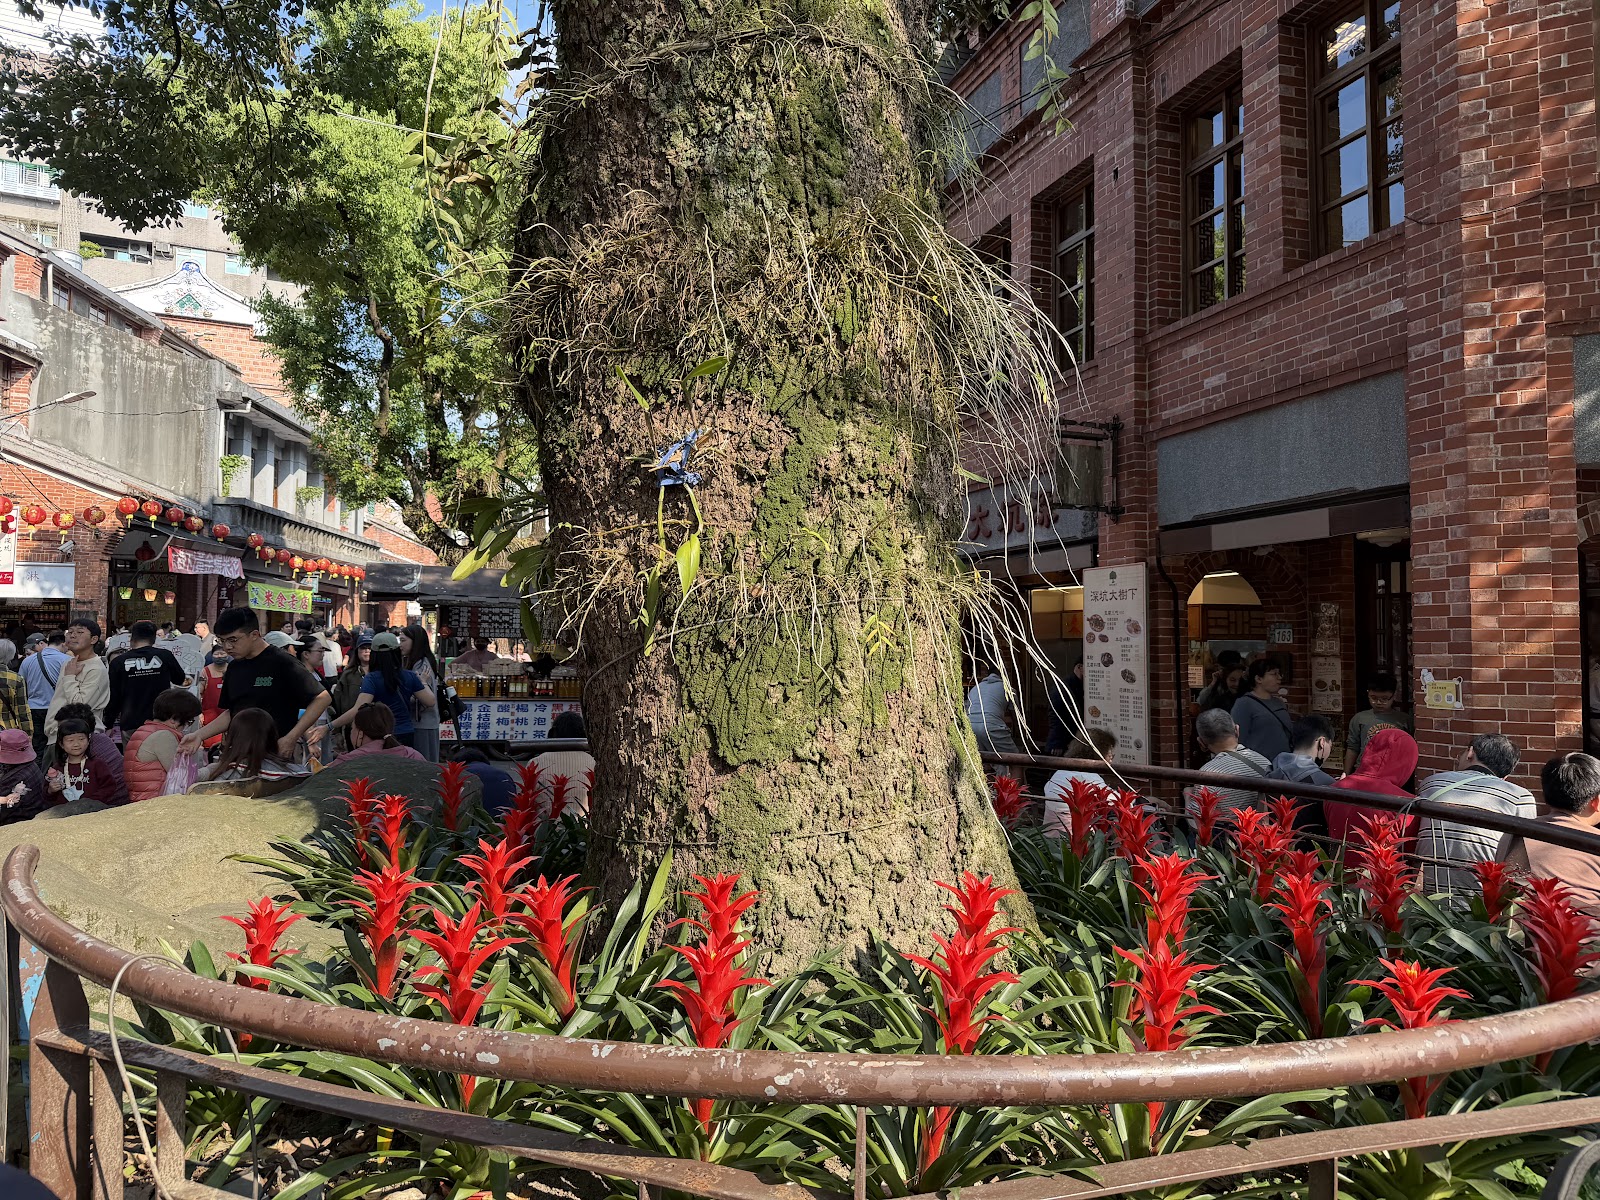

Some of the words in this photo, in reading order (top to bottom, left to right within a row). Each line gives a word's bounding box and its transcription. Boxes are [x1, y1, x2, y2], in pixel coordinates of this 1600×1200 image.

[262, 589, 309, 612] 米食老店
[1090, 588, 1138, 603] 深坑大樹下
[1276, 630, 1292, 642] 163
[124, 655, 163, 672] FILA
[496, 703, 511, 739] 酸梅汁
[514, 703, 529, 739] 楊桃汁
[533, 703, 548, 739] 冷泡茶
